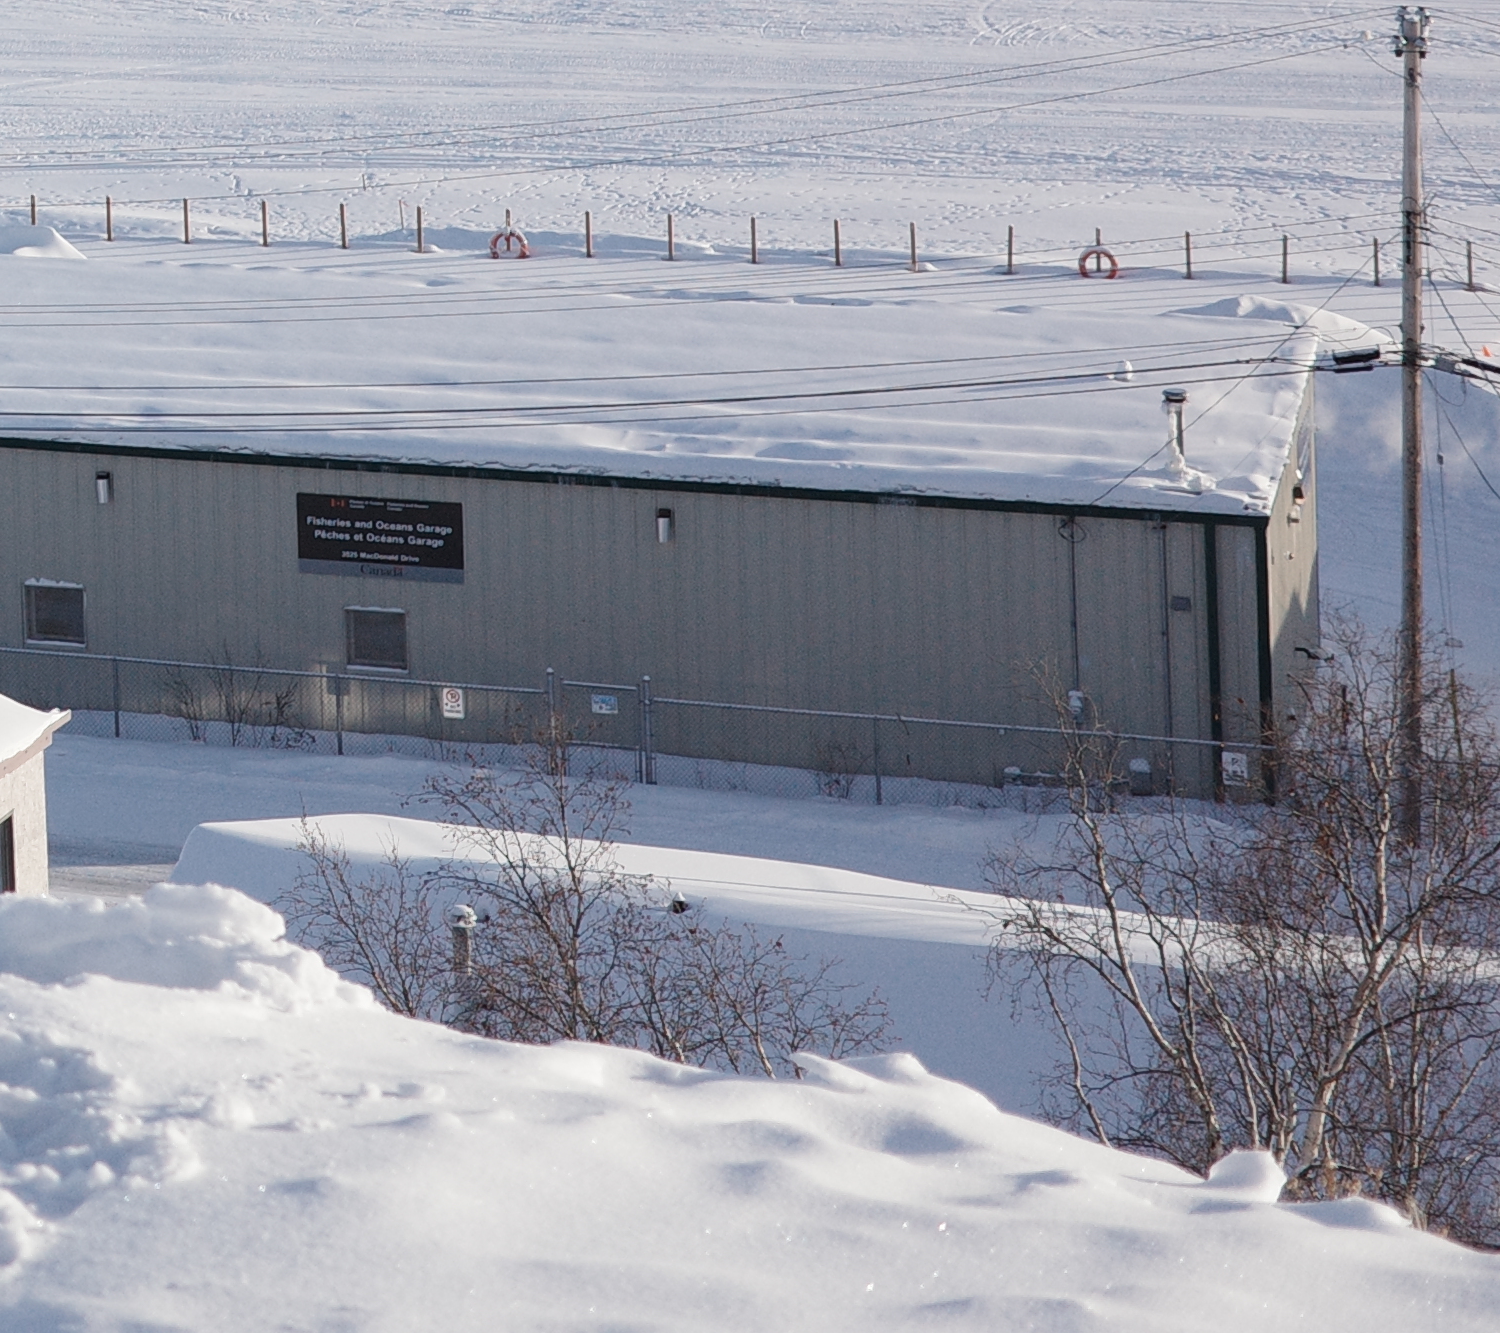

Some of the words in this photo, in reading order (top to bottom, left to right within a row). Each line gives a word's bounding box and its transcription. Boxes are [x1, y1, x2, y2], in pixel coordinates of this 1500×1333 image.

[306, 515, 352, 528] Fisheries
[354, 520, 373, 529] and
[375, 520, 414, 532] Oceans
[416, 523, 453, 536] Garage
[314, 529, 351, 541] Pêches
[353, 533, 364, 542] et
[366, 532, 405, 545] Océans
[407, 535, 445, 548] Garage
[360, 551, 399, 562] MacDonald
[400, 553, 420, 563] Drive
[360, 563, 404, 577] Canada
